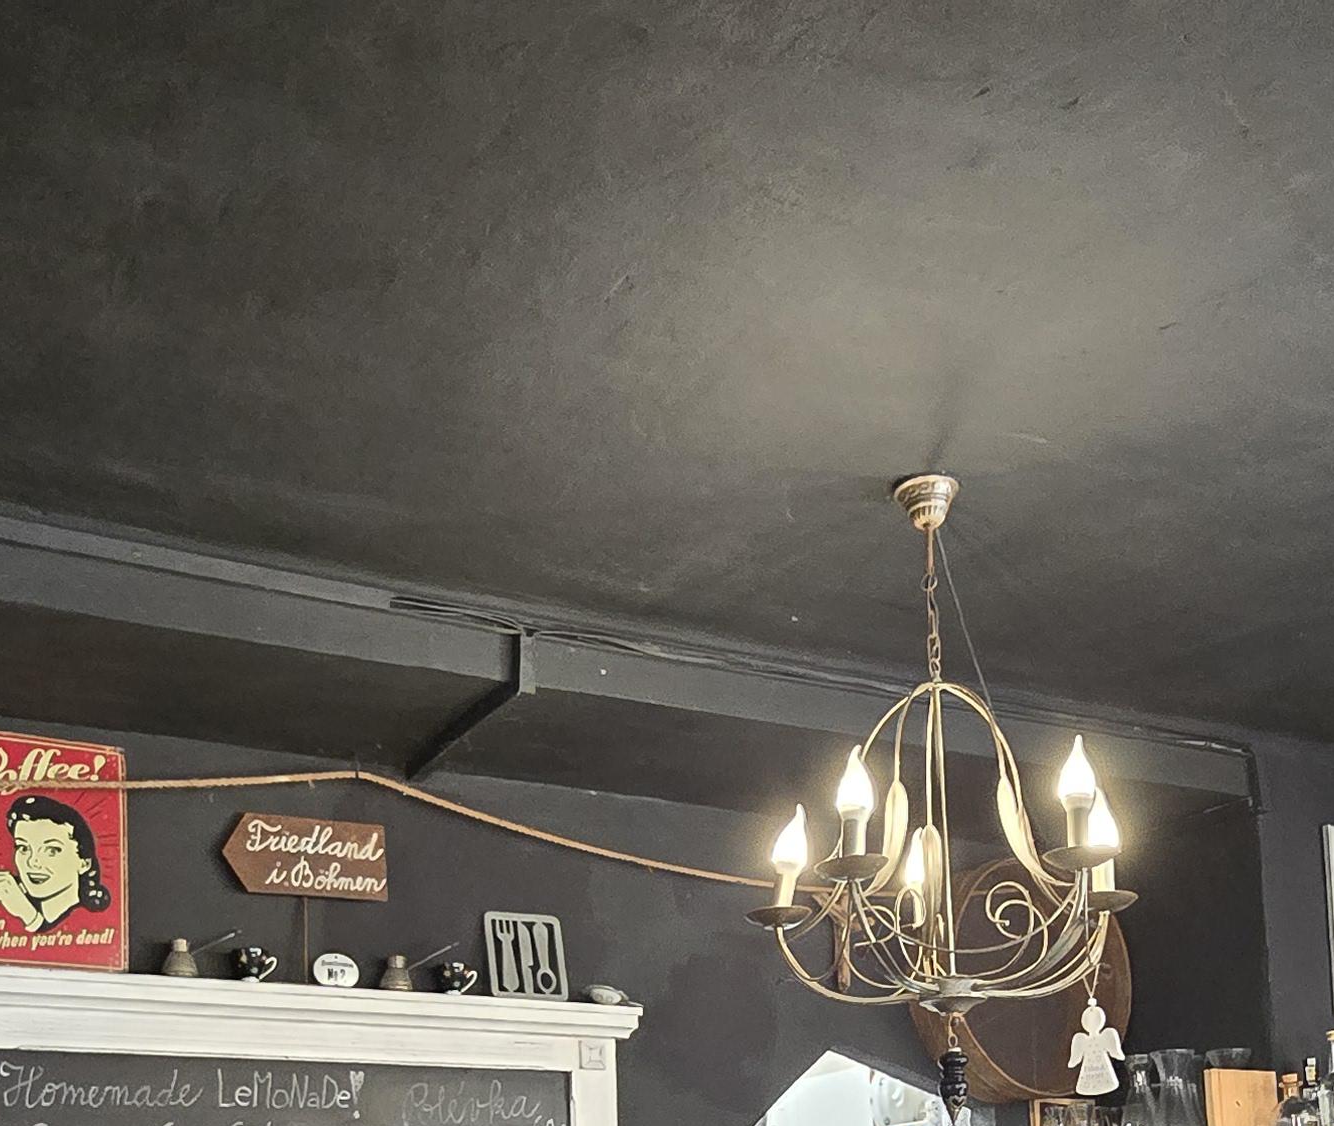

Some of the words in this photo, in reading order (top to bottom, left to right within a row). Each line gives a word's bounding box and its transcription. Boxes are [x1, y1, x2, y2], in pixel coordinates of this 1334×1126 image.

[246, 819, 384, 861] Friedland
[291, 856, 387, 893] Böhmen
[31, 930, 72, 950] you're
[76, 928, 114, 945] dead!
[0, 1061, 203, 1109] Homemade
